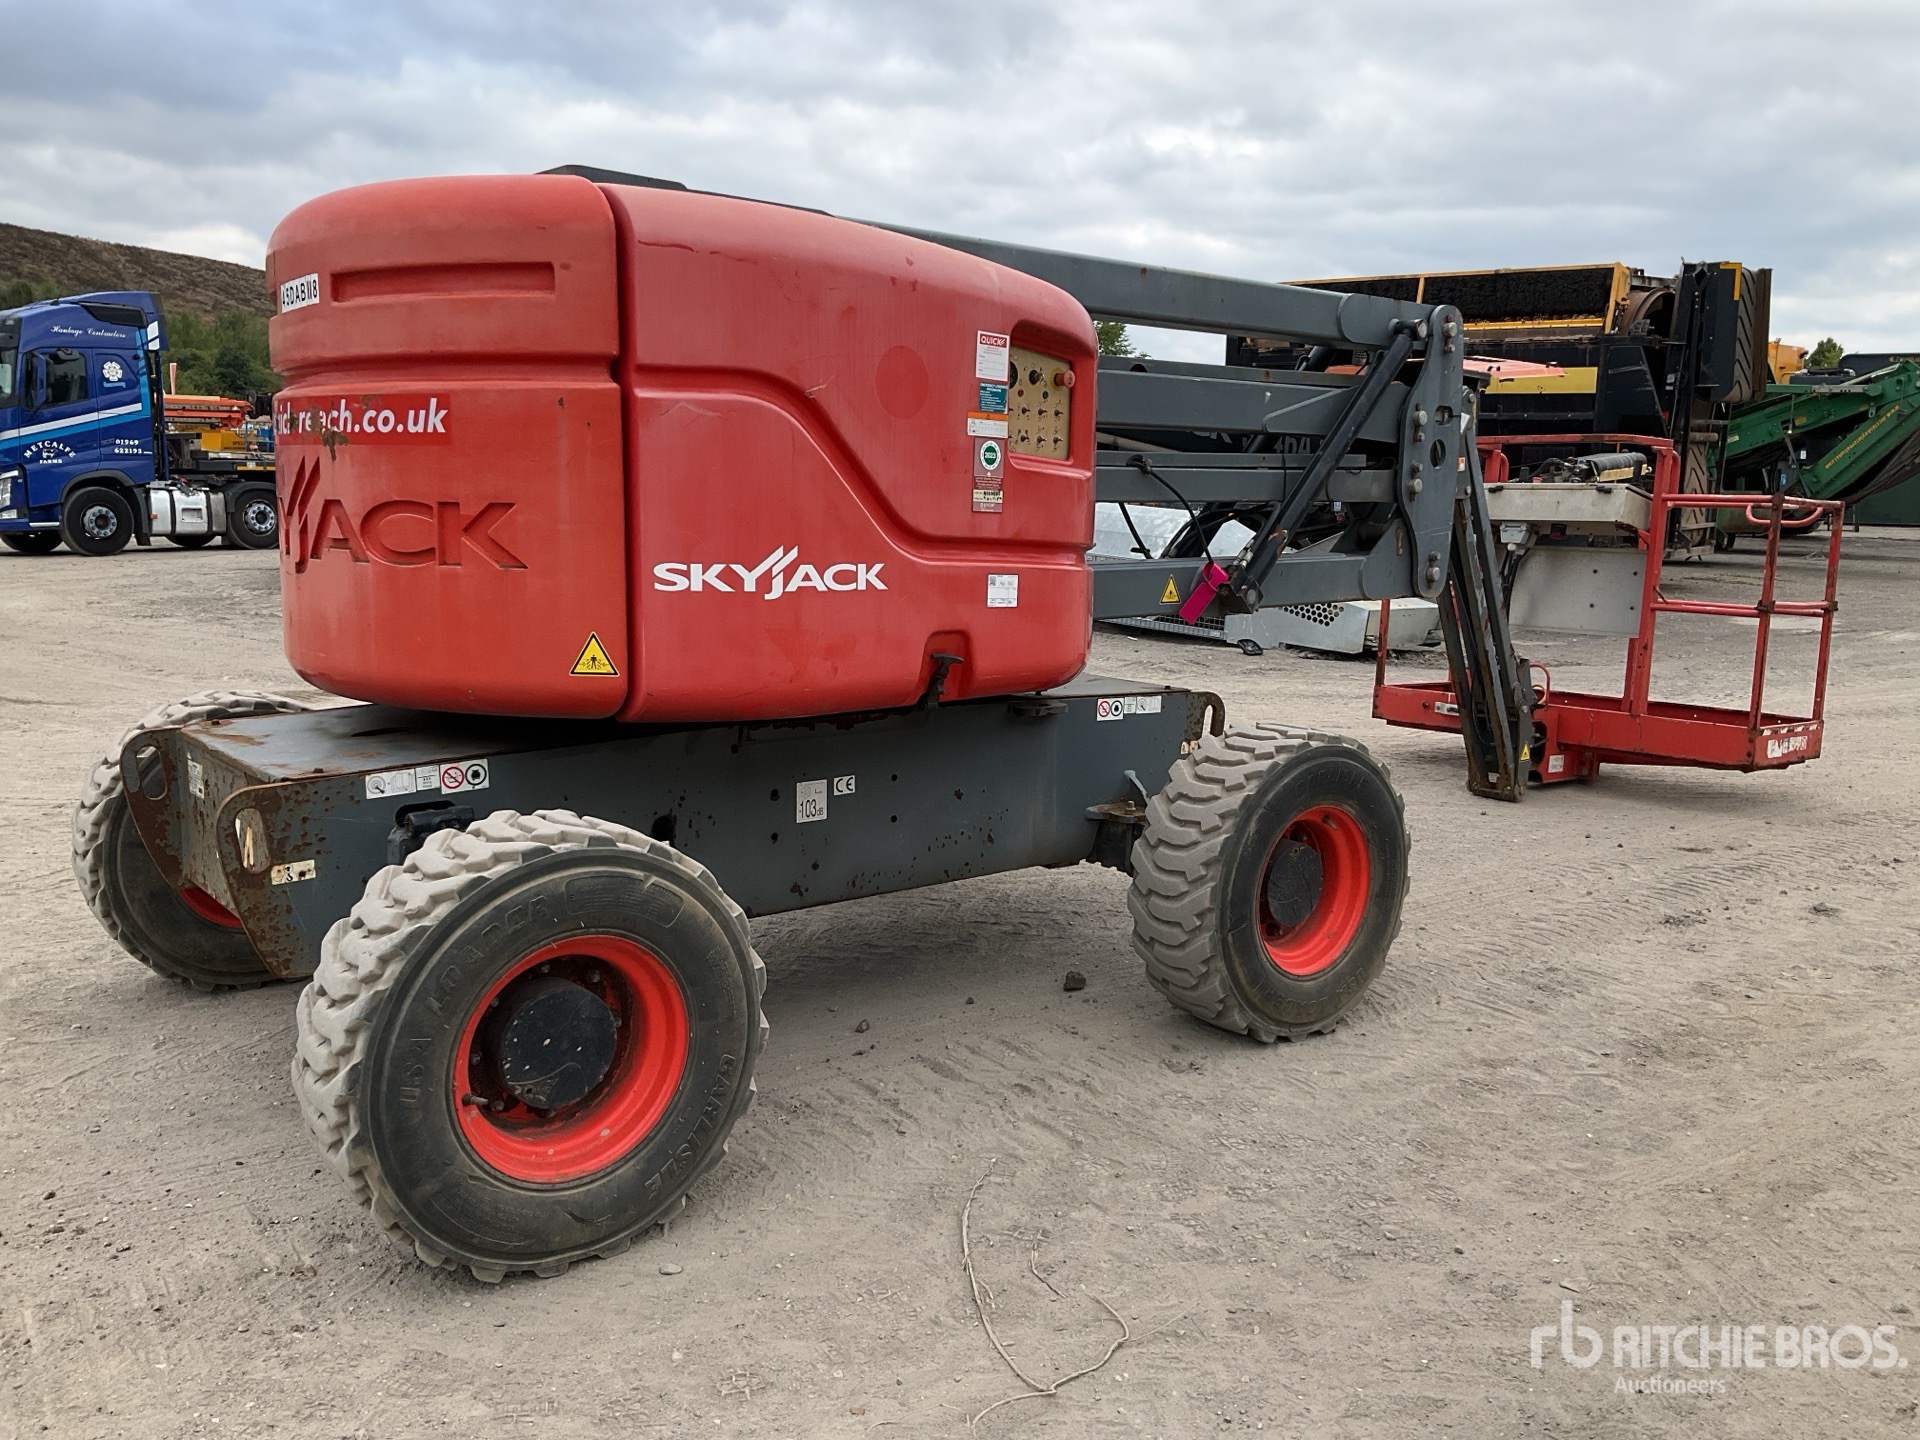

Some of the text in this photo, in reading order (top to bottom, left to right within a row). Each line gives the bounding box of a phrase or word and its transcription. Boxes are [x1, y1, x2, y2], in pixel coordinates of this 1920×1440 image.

[87, 327, 126, 339] Contractors
[24, 440, 76, 458] METCALFE
[653, 545, 888, 600] SKYJACK
[836, 776, 853, 792] CE
[800, 799, 816, 818] 103
[428, 894, 548, 1017] LOADER
